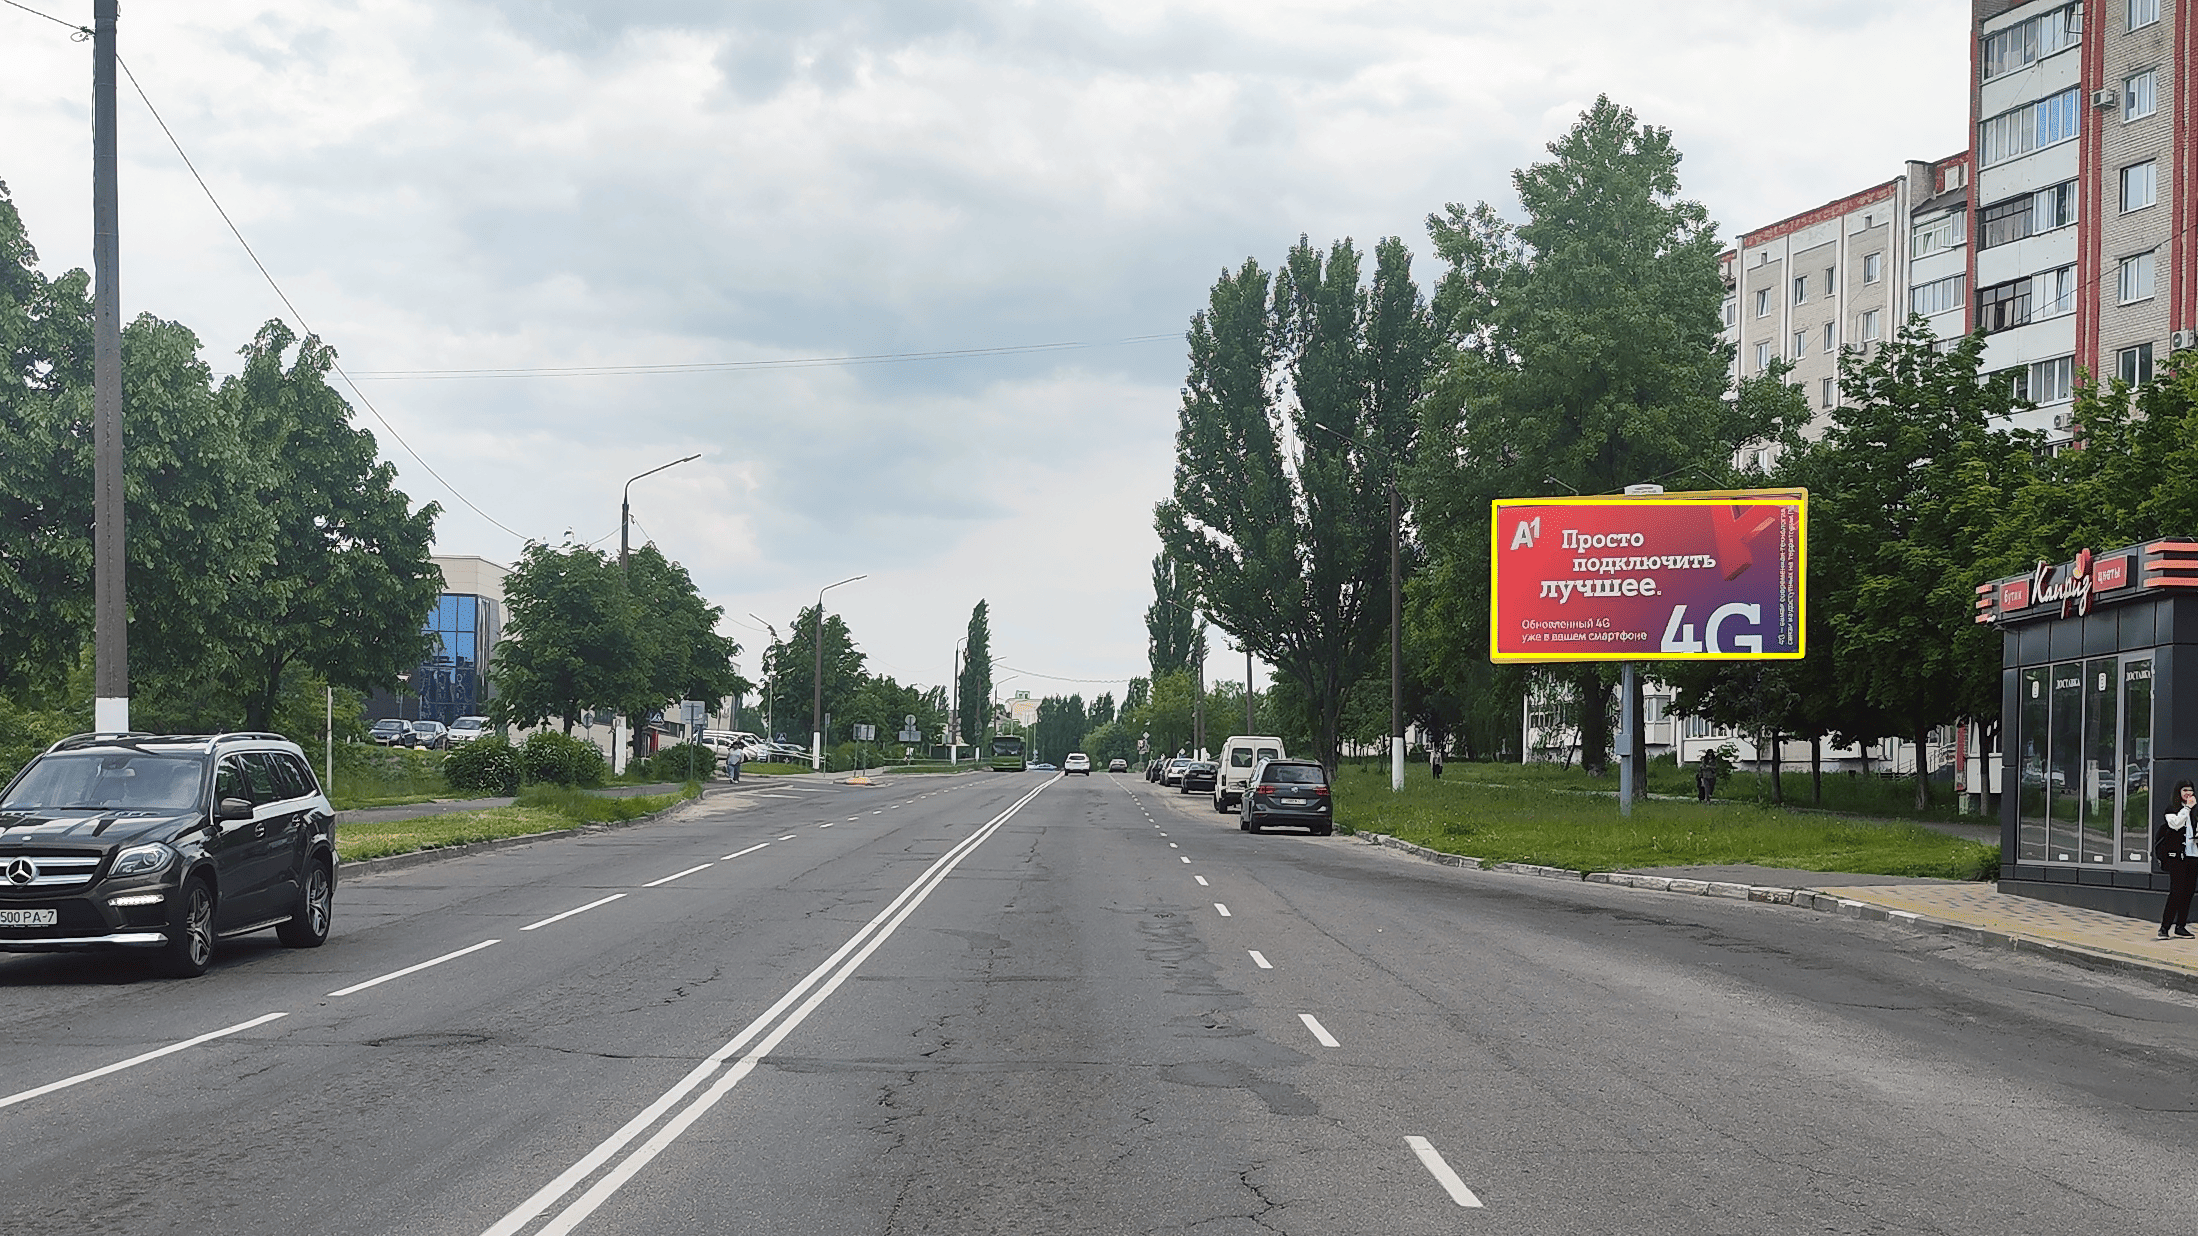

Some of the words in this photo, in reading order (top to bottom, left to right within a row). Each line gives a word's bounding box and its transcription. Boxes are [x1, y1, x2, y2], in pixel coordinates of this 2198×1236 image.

[1562, 529, 1644, 553] Просто
[1572, 554, 1718, 575] подключить
[1540, 577, 1663, 605] лучшее.
[1521, 617, 1594, 630] Обновленный
[1595, 617, 1611, 629] 4G
[1660, 602, 1763, 653] 4G
[1521, 632, 1542, 644] уже
[1543, 632, 1550, 642] в
[1551, 631, 1587, 642] вашем
[1588, 629, 1648, 643] смартфоне
